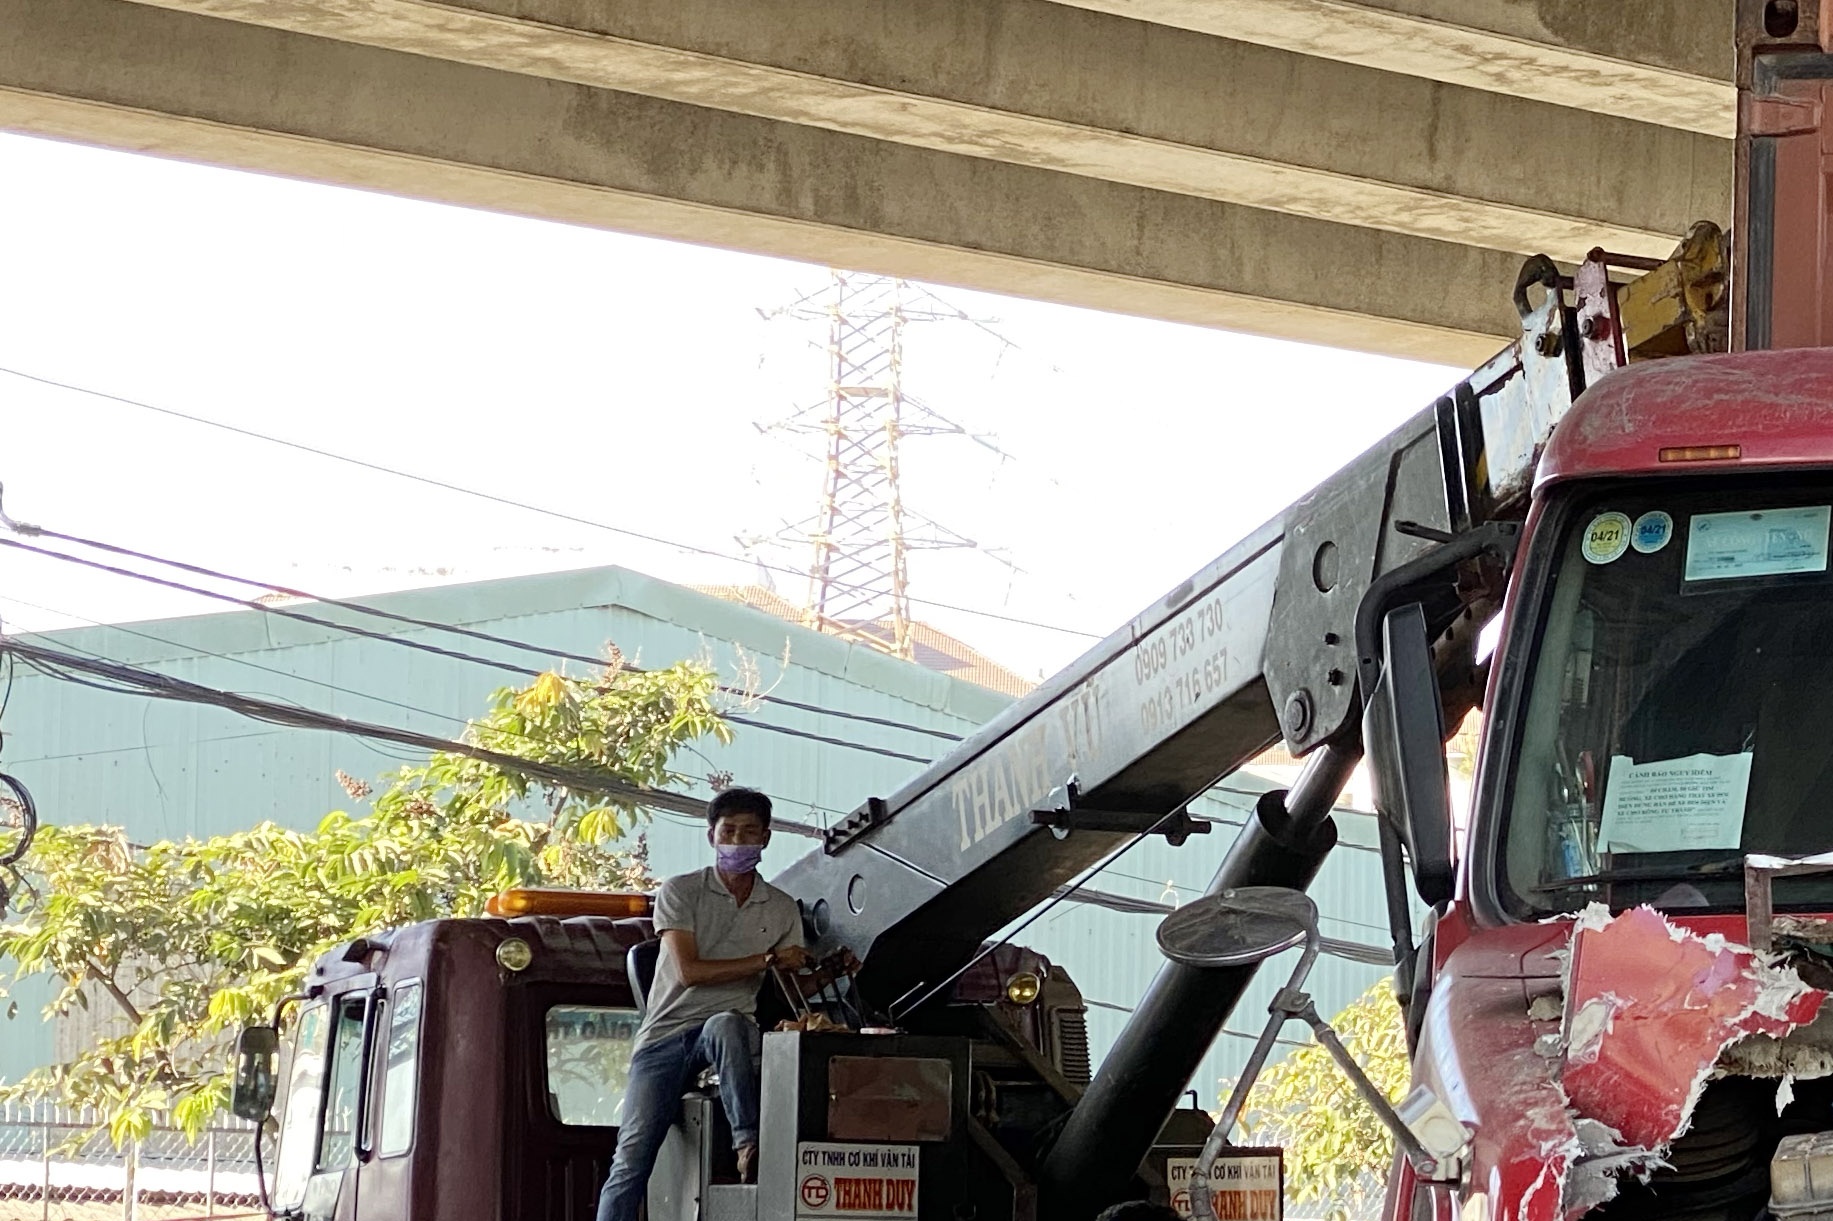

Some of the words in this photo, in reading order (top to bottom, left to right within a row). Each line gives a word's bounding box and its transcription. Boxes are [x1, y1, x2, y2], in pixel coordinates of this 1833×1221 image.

[1591, 528, 1619, 543] 04/21
[1134, 639, 1168, 686] 0909
[1169, 617, 1195, 662] 733
[1197, 598, 1223, 643] 730
[1204, 647, 1227, 692] 657
[802, 1150, 819, 1166] CTY
[822, 1151, 846, 1167] TNHH
[834, 1177, 884, 1210] THANH
[885, 1179, 916, 1212] DUY
[1211, 1190, 1249, 1221] HANH
[1250, 1190, 1277, 1221] DUY
